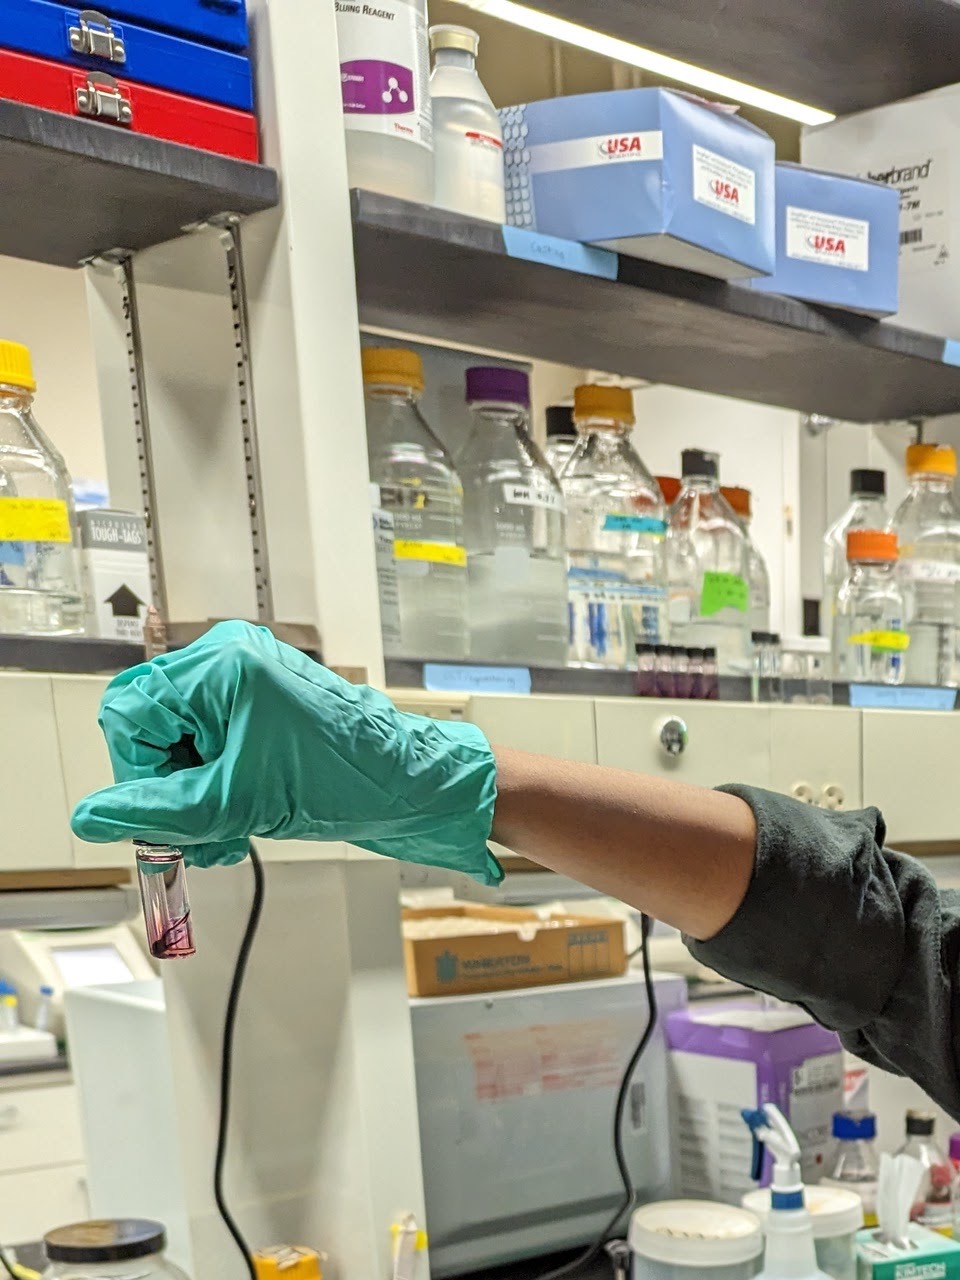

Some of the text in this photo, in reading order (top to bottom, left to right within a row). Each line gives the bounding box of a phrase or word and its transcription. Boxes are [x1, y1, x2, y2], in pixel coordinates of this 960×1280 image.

[362, 4, 396, 21] REAGENT
[607, 136, 641, 154] USA
[713, 179, 739, 203] USA
[814, 234, 846, 253] USA
[90, 526, 142, 545] TOUGH-TAGS
